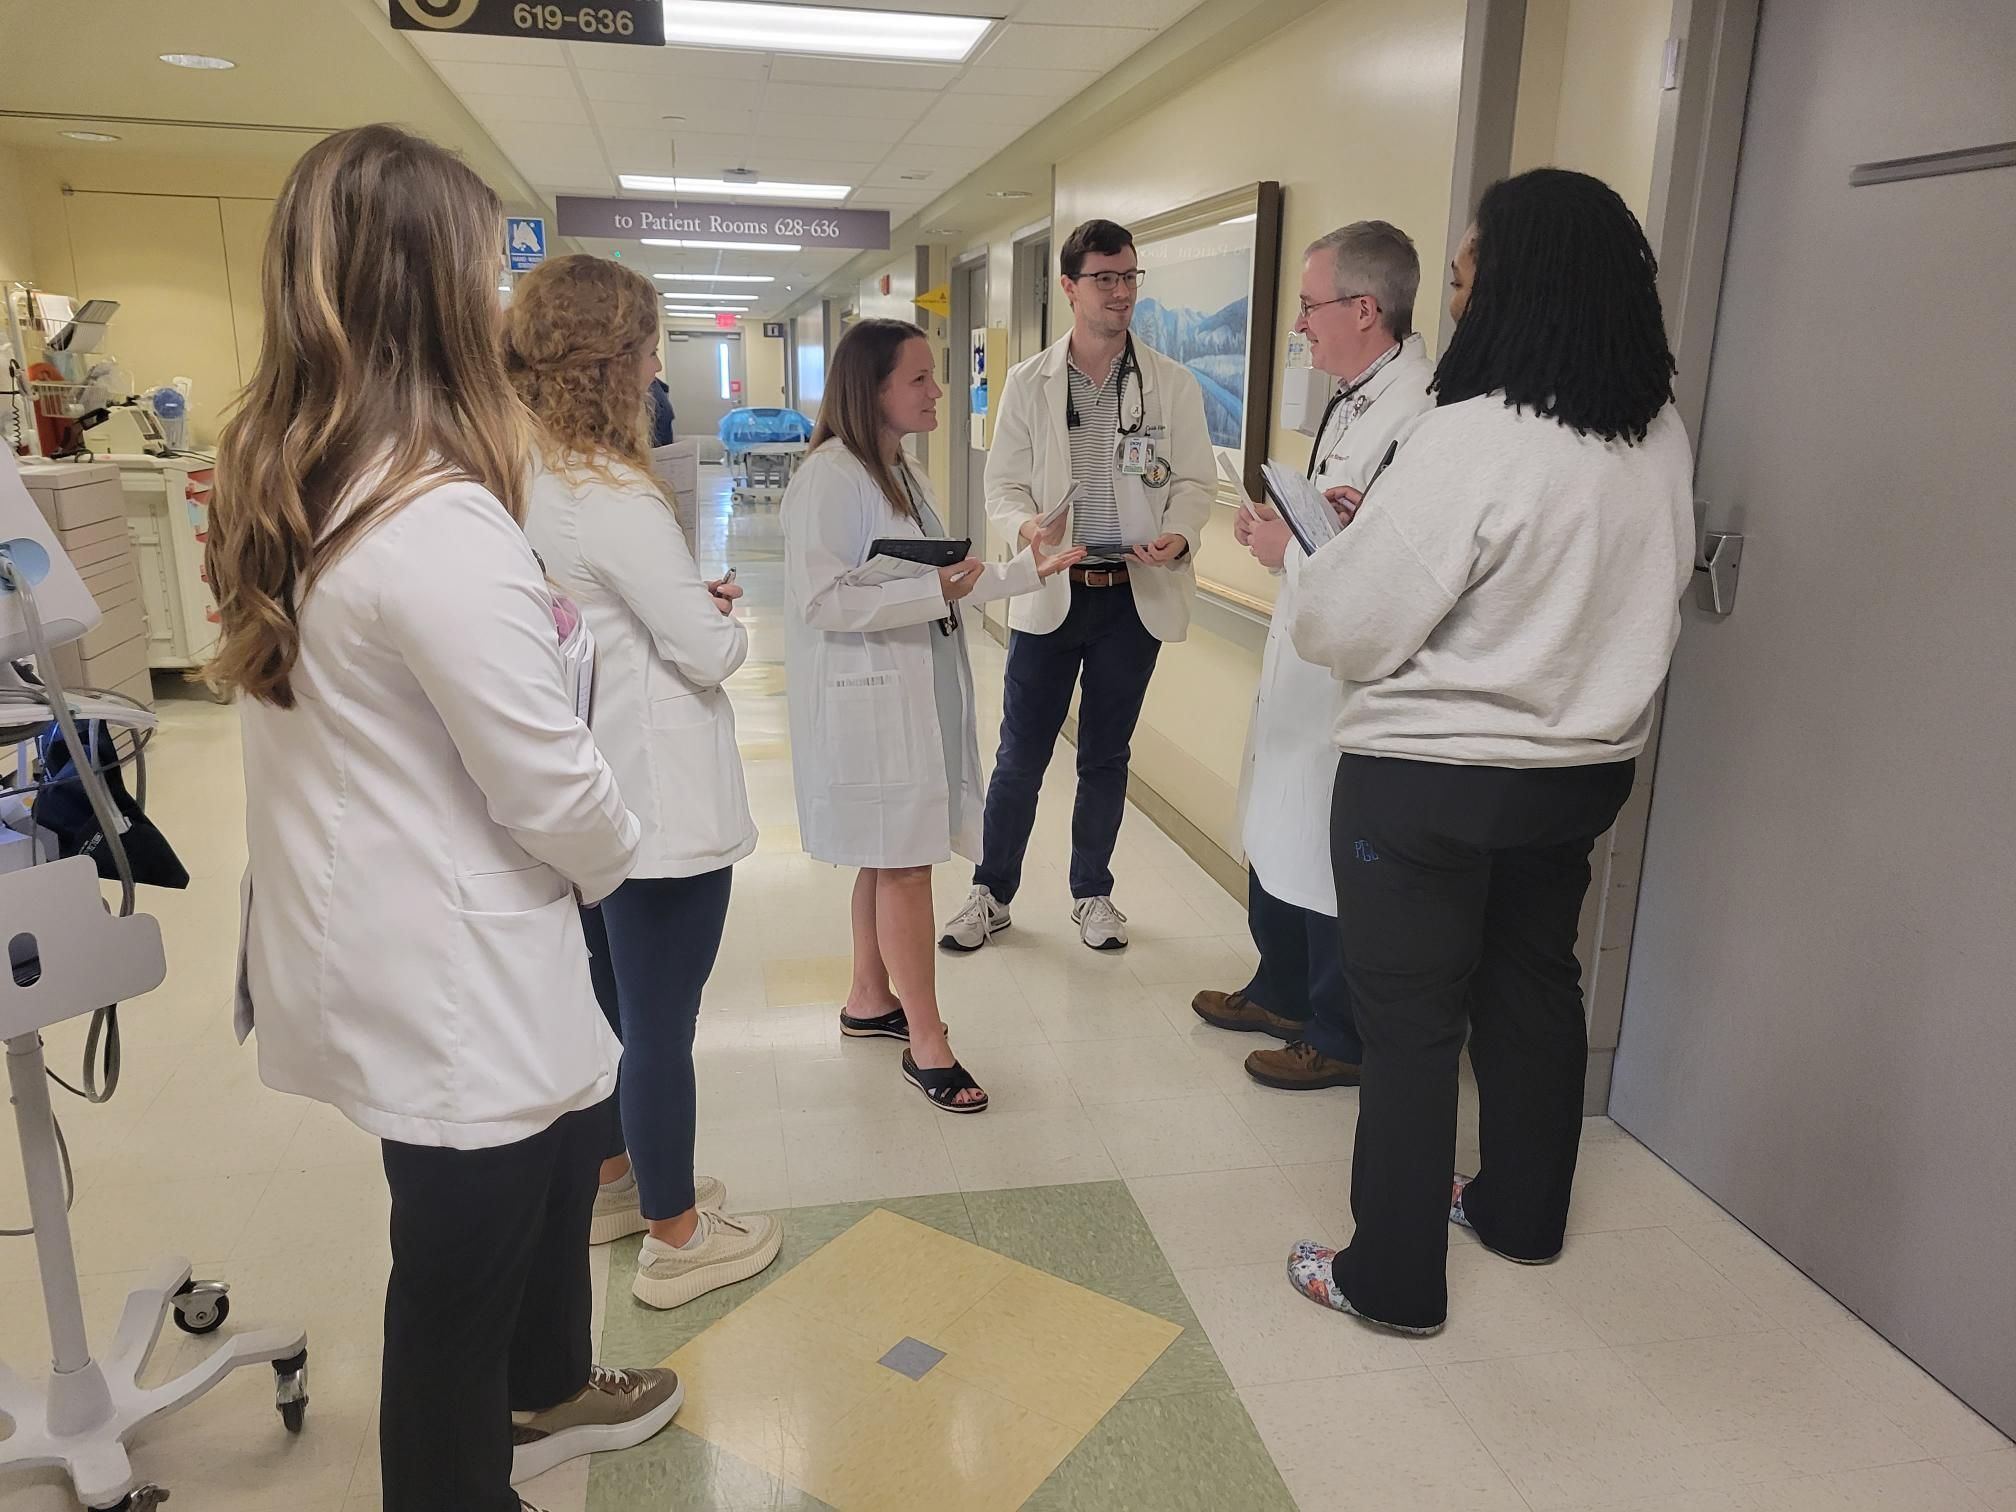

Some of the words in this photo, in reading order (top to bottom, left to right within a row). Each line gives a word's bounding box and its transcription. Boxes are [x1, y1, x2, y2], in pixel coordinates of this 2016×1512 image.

[513, 3, 634, 36] 619-636
[614, 214, 632, 228] to
[640, 212, 701, 232] Patient
[709, 215, 768, 234] Rooms
[774, 218, 839, 238] 628-636
